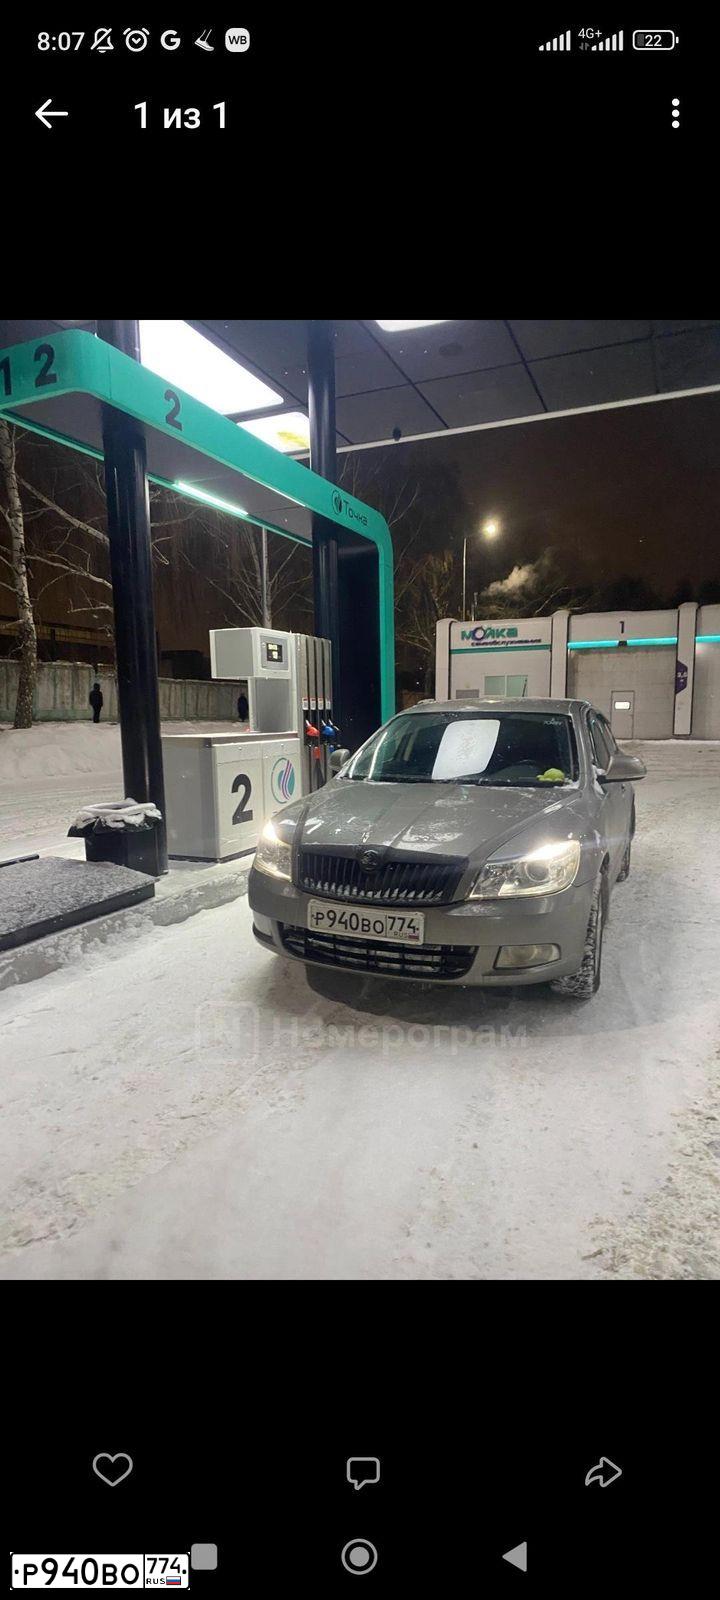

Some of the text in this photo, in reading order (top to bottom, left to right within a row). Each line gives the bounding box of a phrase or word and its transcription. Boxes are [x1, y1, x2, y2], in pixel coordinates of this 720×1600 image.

[0, 343, 58, 396] 1 2
[164, 389, 182, 431] 2
[619, 620, 625, 634] 1
[231, 773, 254, 826] 2
[388, 915, 416, 934] 774
